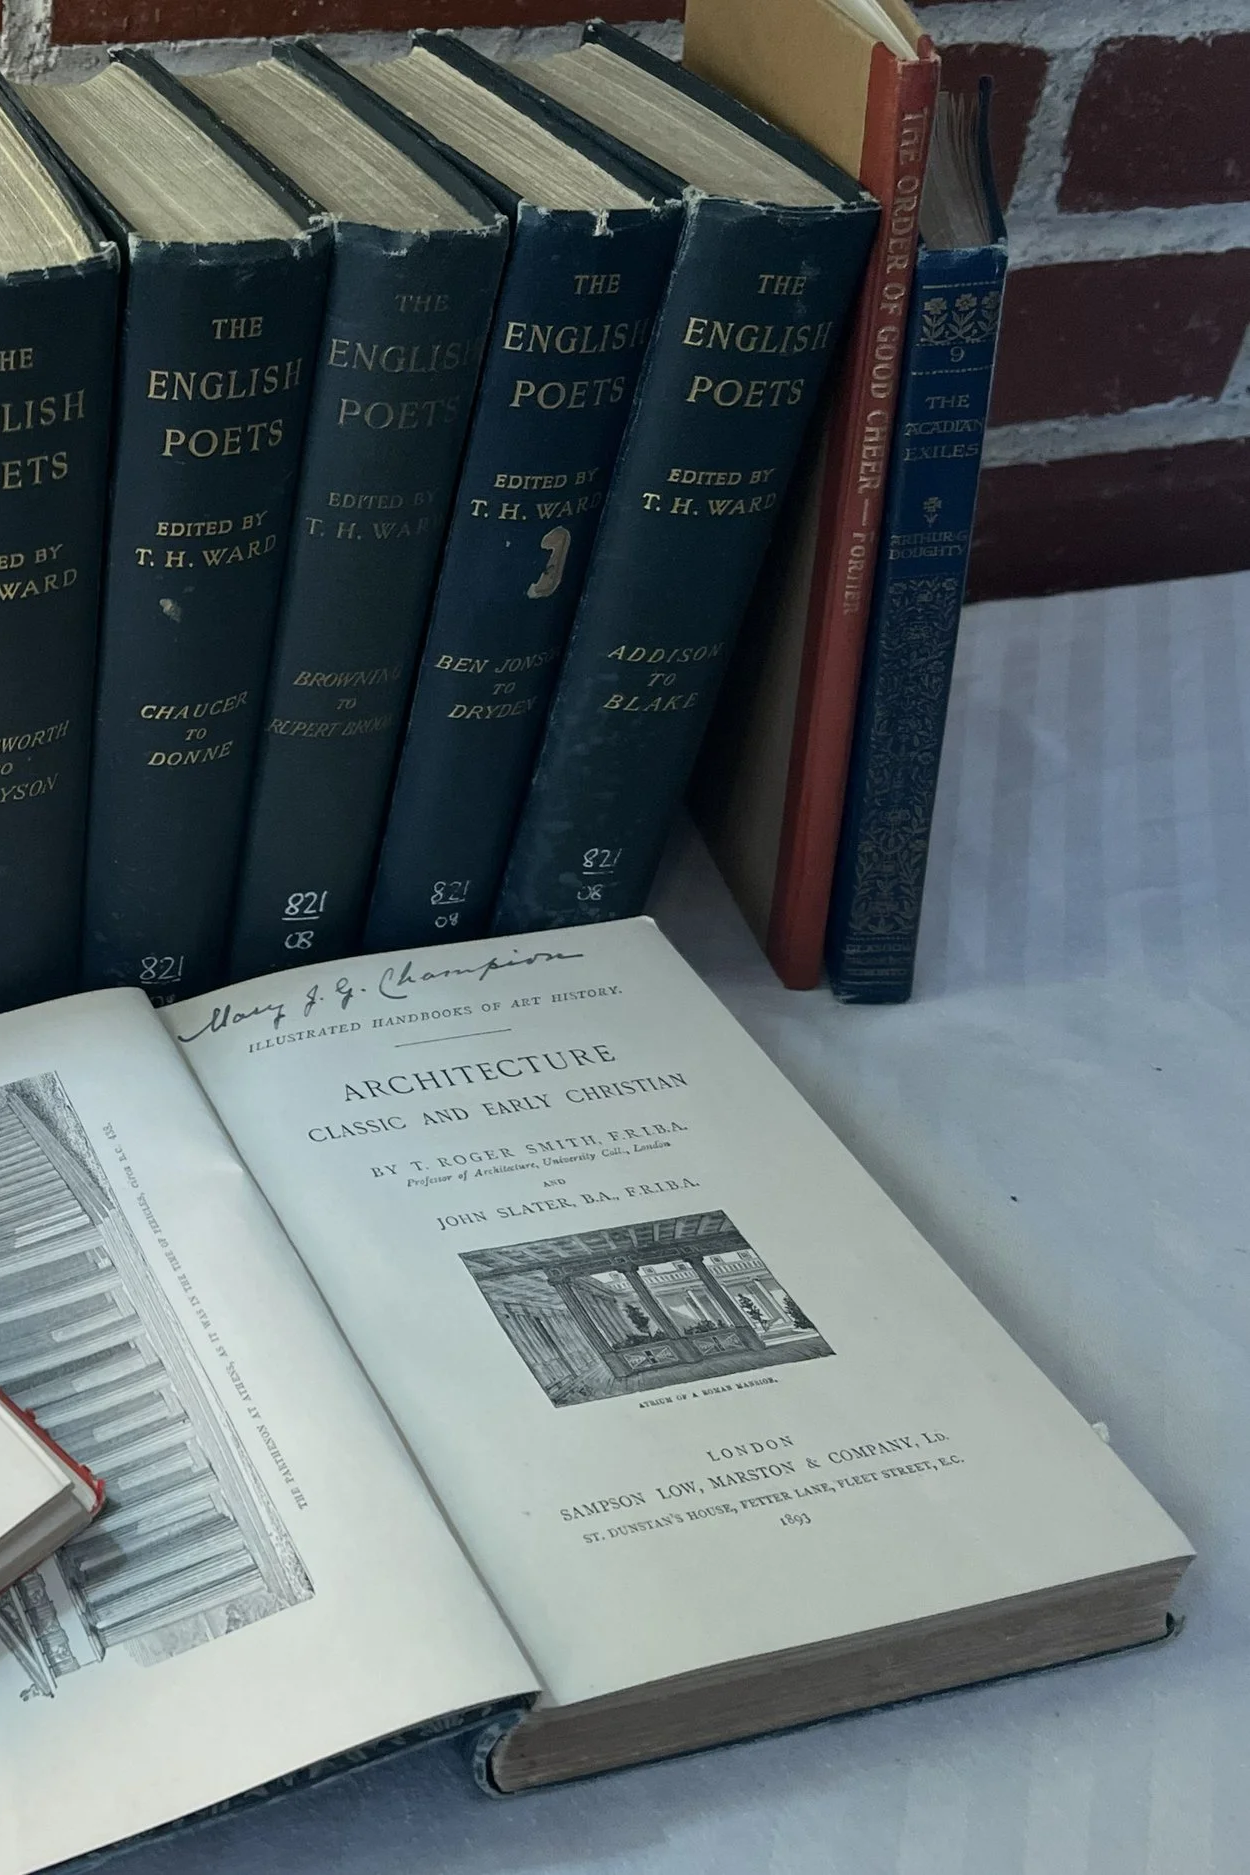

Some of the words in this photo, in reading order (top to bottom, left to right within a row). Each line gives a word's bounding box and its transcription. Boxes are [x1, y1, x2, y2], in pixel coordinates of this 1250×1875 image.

[886, 175, 919, 274] ORDER
[573, 273, 621, 295] THE
[757, 274, 807, 295] THE
[880, 282, 906, 314] OF
[212, 316, 263, 340] THE
[502, 318, 648, 354] ENGLISH
[682, 316, 833, 353] ENGLISH
[871, 326, 898, 399] GOOD
[950, 346, 965, 362] 9
[147, 358, 302, 401] ENGLISH
[686, 375, 805, 408] POETS
[509, 376, 626, 410] POETS
[925, 394, 971, 411] THE
[162, 419, 283, 457] POETS
[858, 410, 887, 493] CHEER
[903, 443, 979, 461] EXILES
[493, 473, 568, 491] EDITED
[574, 467, 599, 485] BY
[667, 468, 742, 486] EDITED
[750, 468, 776, 485] BY
[470, 499, 489, 518] T.
[498, 503, 527, 521] H.
[642, 492, 661, 511] T.
[670, 497, 699, 515] H.
[708, 492, 777, 517] WARD
[156, 519, 233, 537] EDITED
[242, 511, 268, 531] BY
[34, 544, 64, 565] BY
[136, 548, 155, 567] T.
[165, 551, 194, 568] H.
[203, 534, 277, 567] WARD
[433, 654, 487, 676] BEN
[607, 642, 725, 664] ADDISON
[493, 682, 516, 697] TO
[647, 672, 677, 687] TO
[140, 691, 249, 720] CHAUCER
[603, 692, 700, 712] BLAKE
[185, 727, 207, 741] TO
[147, 741, 234, 766] DONNE
[582, 847, 622, 869] 821
[284, 890, 327, 916] 821
[431, 880, 471, 901] 821
[434, 913, 460, 928] 08
[140, 955, 184, 981] 821
[177, 1005, 285, 1043] Mary
[379, 950, 584, 999] Champion
[248, 1022, 362, 1054] ILLUSTRATED
[372, 1006, 473, 1030] HANDBOOKS
[481, 1001, 502, 1013] OF
[510, 995, 541, 1009] ART
[551, 986, 623, 1004] HISTORY.
[344, 1043, 616, 1102] ARCHITECTURE
[307, 1115, 407, 1144] CLASSIC
[422, 1106, 470, 1128] AND
[482, 1093, 552, 1118] EARLY
[565, 1072, 689, 1104] CHRISTIAN
[369, 1163, 399, 1179] BY
[410, 1159, 429, 1172] T.
[437, 1147, 517, 1168] ROGER
[525, 1134, 602, 1156] SMITH,
[406, 1171, 453, 1189] Professor
[458, 1170, 469, 1182] of
[474, 1159, 539, 1178] Architecture,
[543, 1151, 596, 1169] University
[633, 1138, 671, 1153] London
[542, 1177, 567, 1189] AND
[436, 1211, 488, 1232] JOHN
[496, 1196, 577, 1220] SLATER,
[638, 1395, 674, 1410] ATRIUM
[255, 1425, 296, 1487] PARTHENON
[706, 1435, 796, 1464] LONDON
[559, 1491, 647, 1523] SAMPSON
[656, 1481, 705, 1502] LOW,
[708, 1461, 797, 1490] MARSTON
[806, 1457, 821, 1469] &
[827, 1436, 920, 1465] COMPANY,
[288, 1484, 308, 1510] THE
[583, 1532, 606, 1545] ST.
[608, 1513, 685, 1539] DUNSTAN'S
[688, 1503, 739, 1522] HOUSE,
[740, 1491, 793, 1511] FETTER
[795, 1483, 836, 1500] LANE,
[837, 1473, 879, 1490] FLEET
[881, 1460, 938, 1479] STREET,
[779, 1512, 812, 1528] 1893
